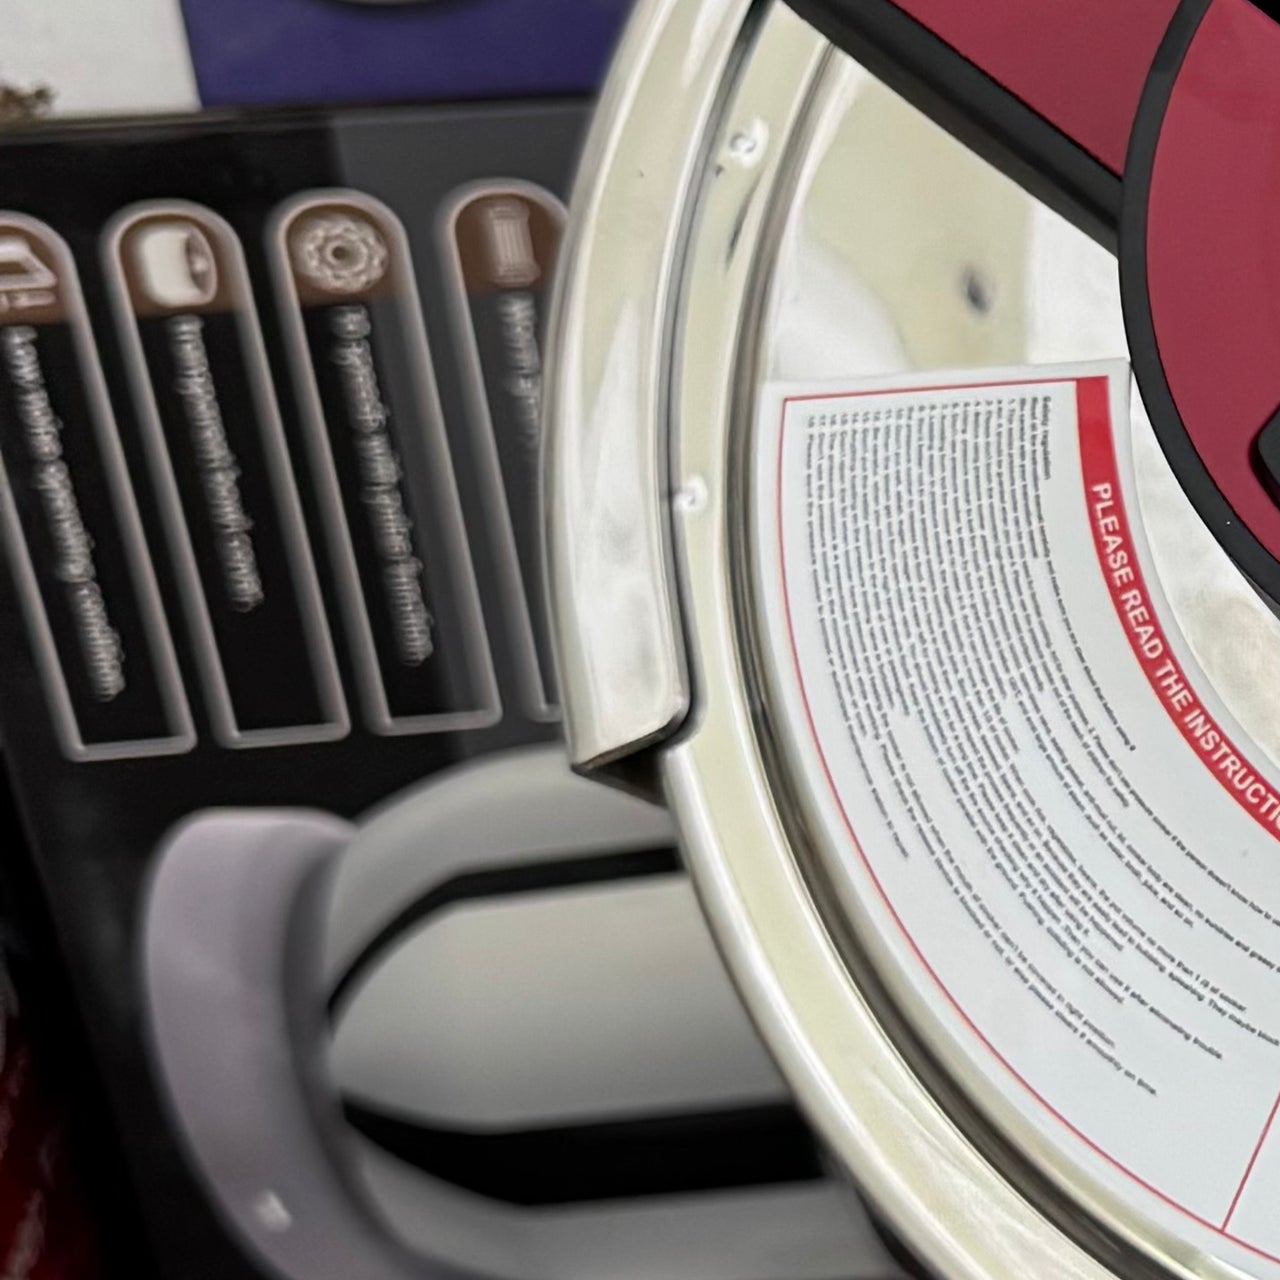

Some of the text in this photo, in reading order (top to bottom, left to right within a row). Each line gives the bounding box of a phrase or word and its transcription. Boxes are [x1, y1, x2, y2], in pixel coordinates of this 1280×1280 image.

[1091, 482, 1135, 588] PLEASE
[1120, 587, 1164, 660] READ
[1154, 658, 1193, 712] THE
